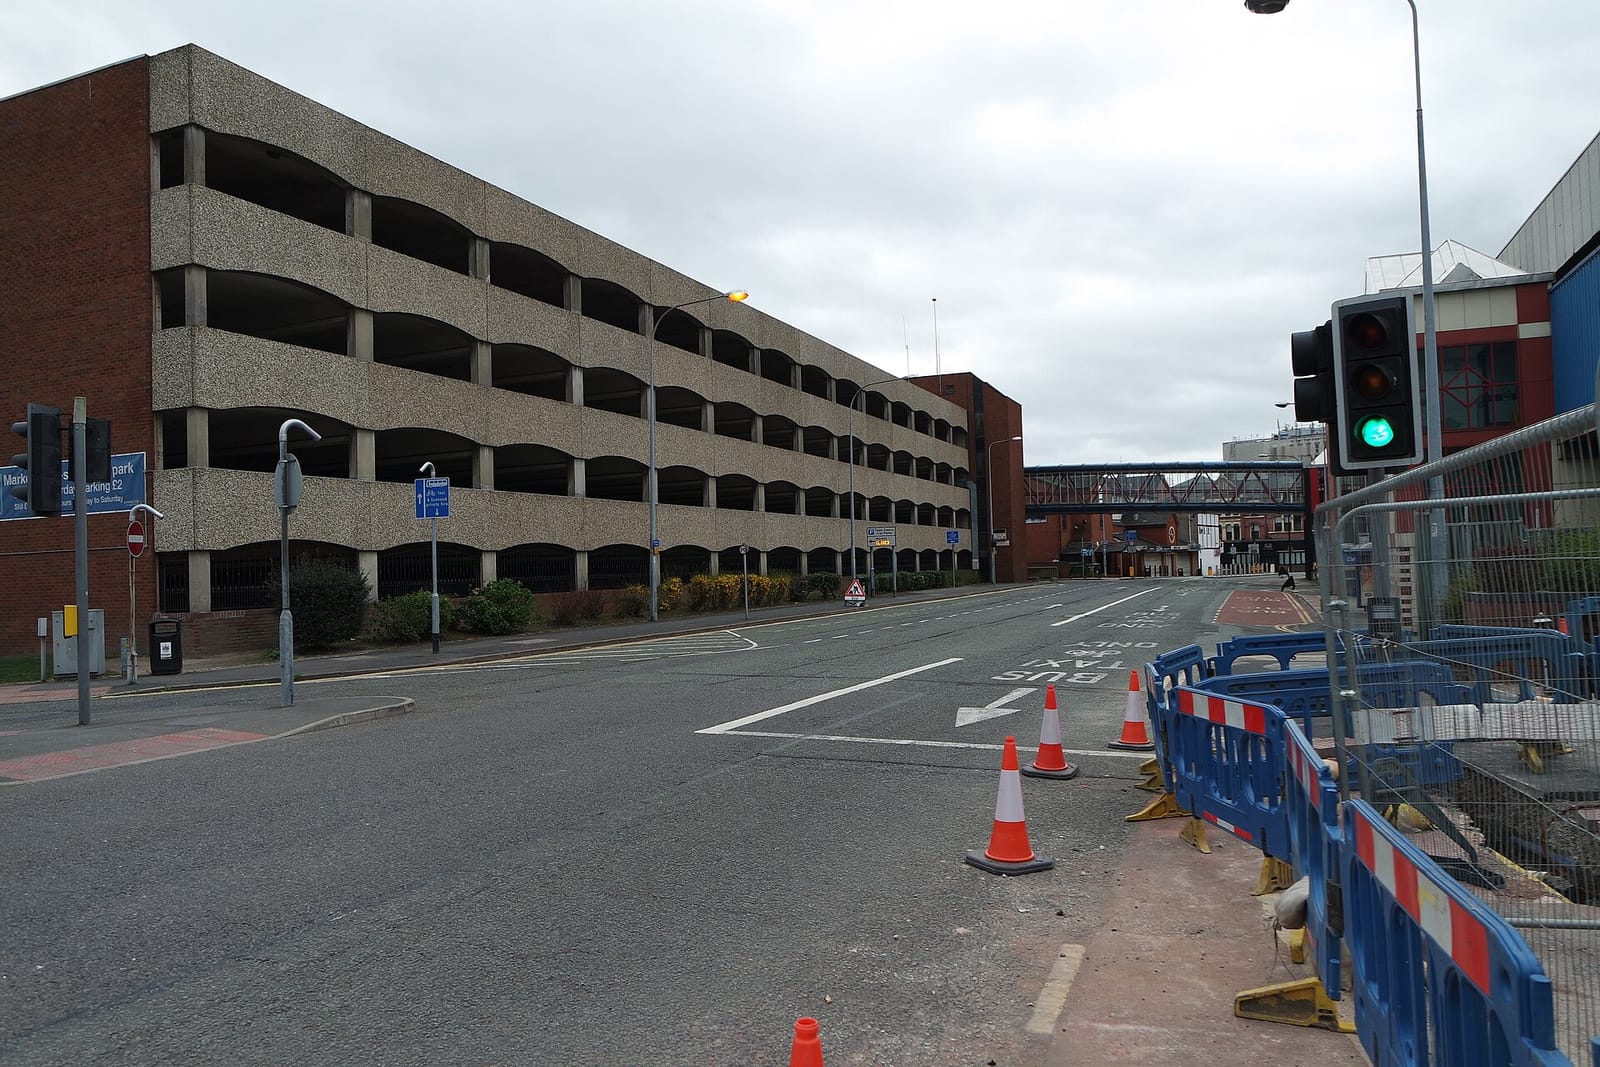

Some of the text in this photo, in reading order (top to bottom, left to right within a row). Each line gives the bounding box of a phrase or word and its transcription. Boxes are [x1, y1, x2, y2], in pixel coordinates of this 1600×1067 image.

[112, 462, 134, 477] park
[86, 481, 111, 493] arking
[112, 479, 123, 490] £2
[101, 496, 124, 504] Saturday
[1019, 659, 1127, 670] TAXI
[991, 670, 1109, 684] BUS
